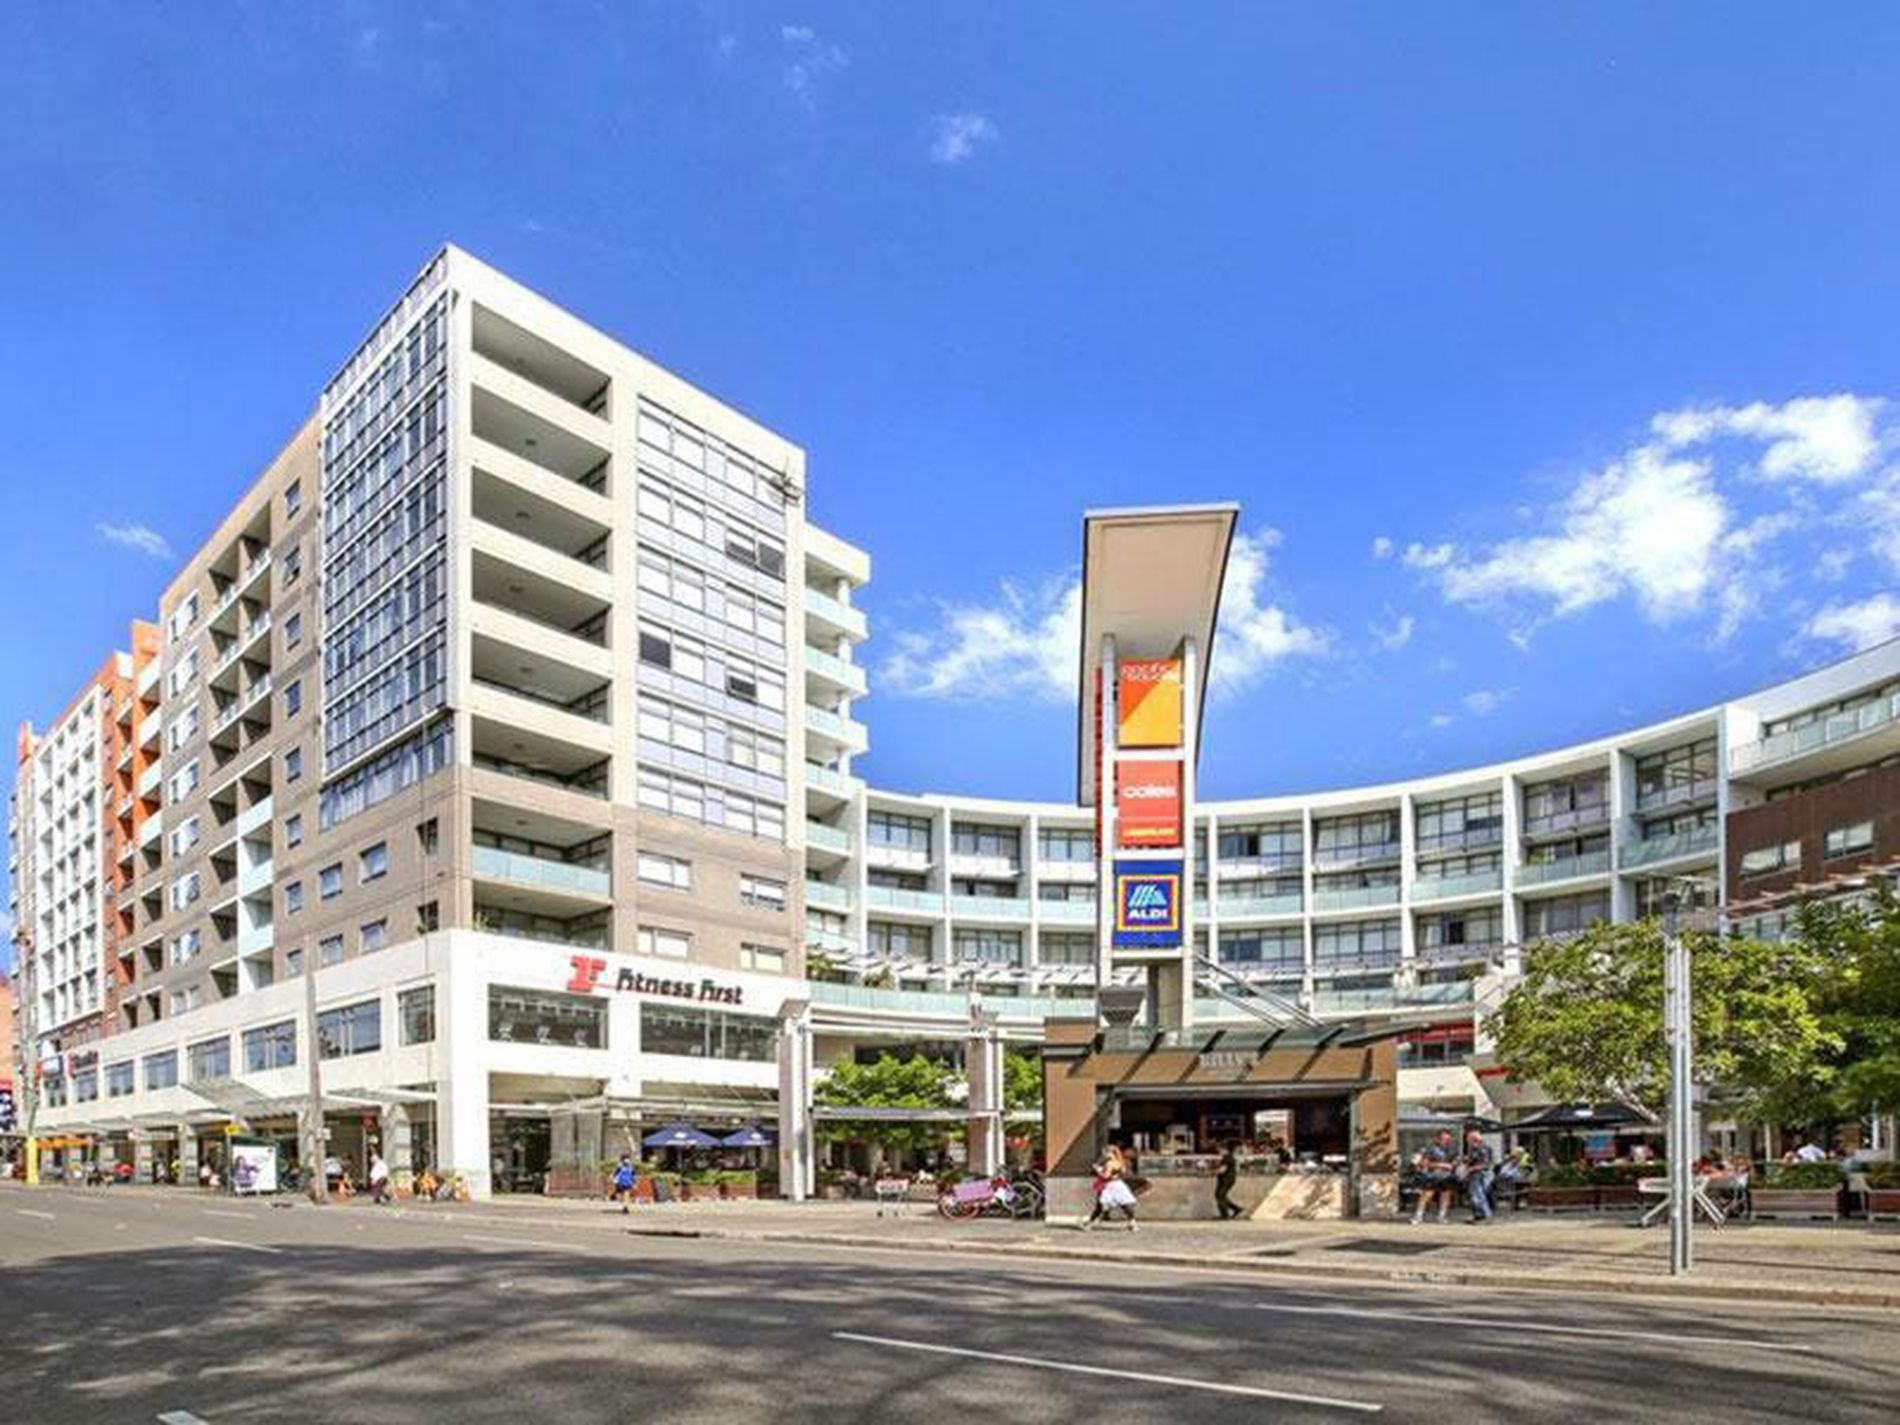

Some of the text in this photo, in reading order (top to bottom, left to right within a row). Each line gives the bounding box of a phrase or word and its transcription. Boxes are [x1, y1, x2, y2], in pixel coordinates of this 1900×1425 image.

[1127, 908, 1168, 919] ALDI
[616, 967, 743, 1005] Fitness First
